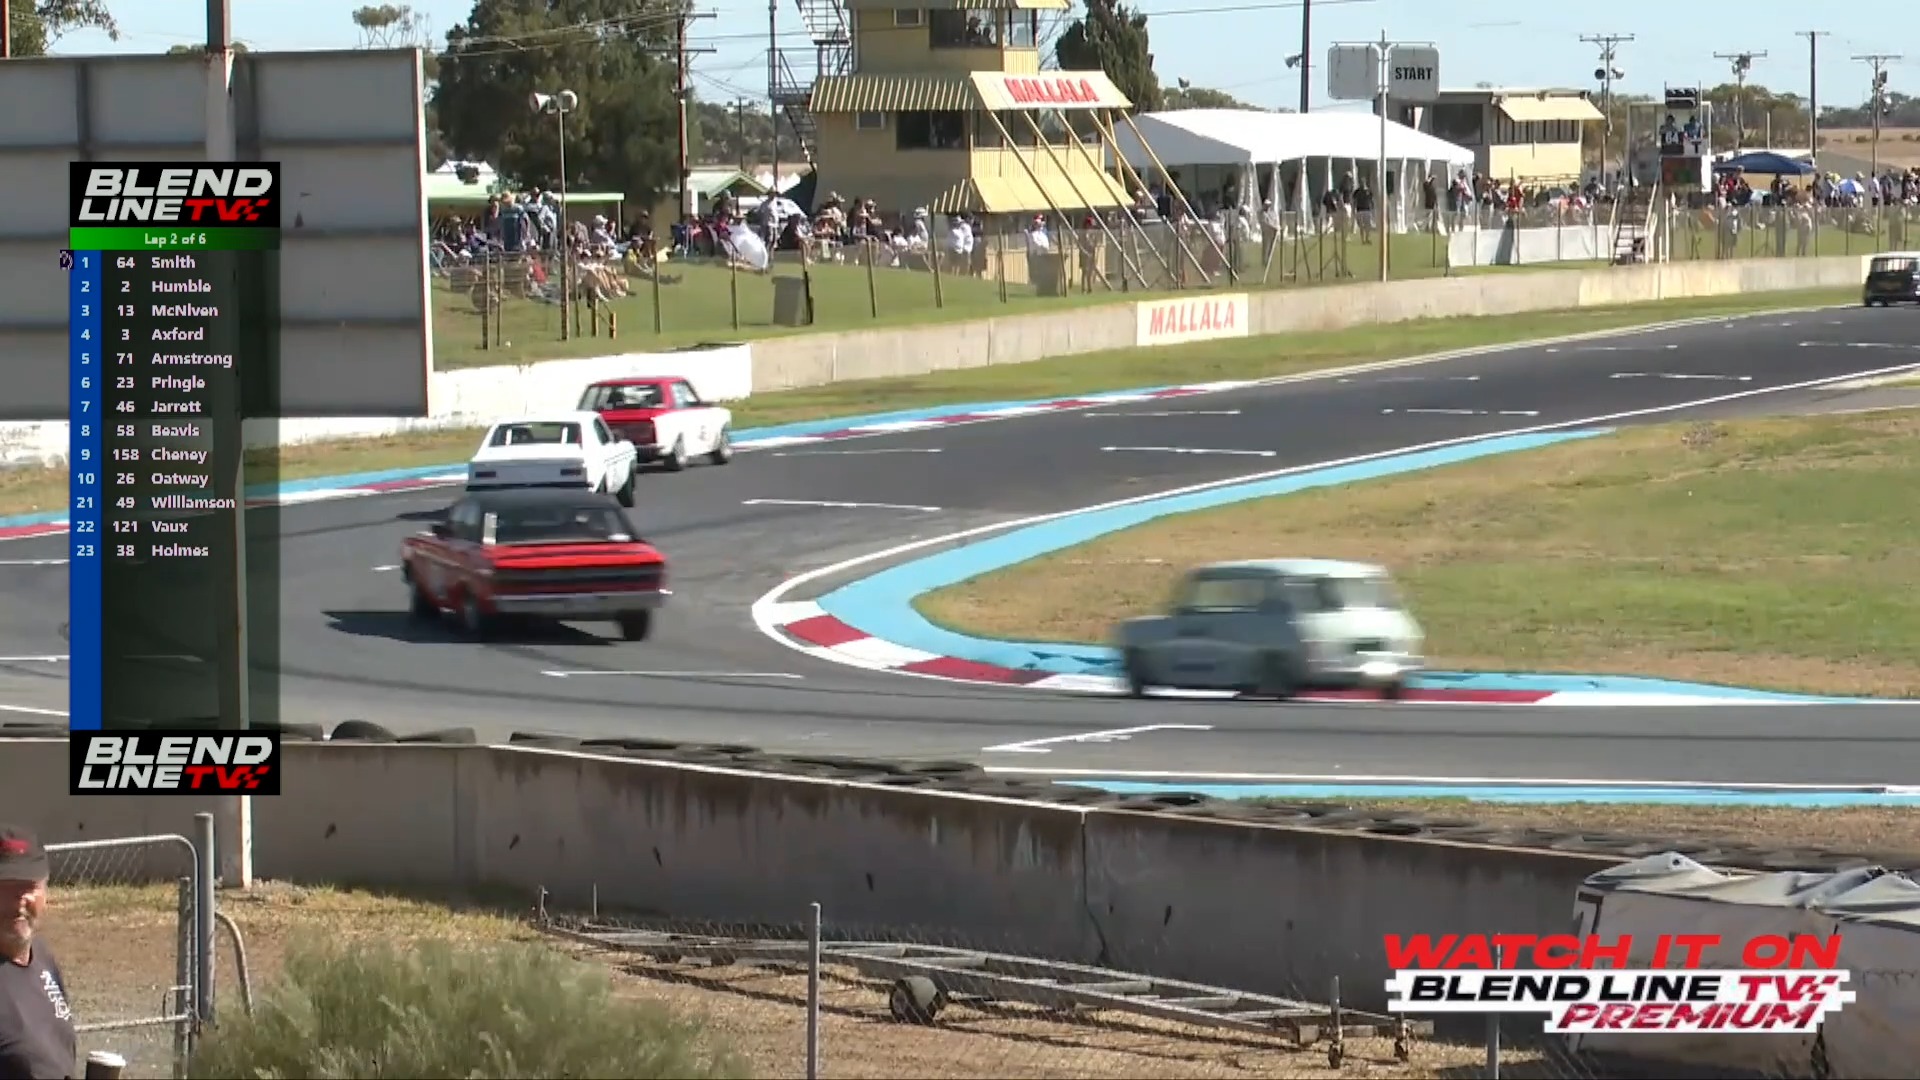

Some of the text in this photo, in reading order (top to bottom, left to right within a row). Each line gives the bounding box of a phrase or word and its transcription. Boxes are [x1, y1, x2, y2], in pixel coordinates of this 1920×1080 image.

[1395, 66, 1433, 80] START
[1004, 77, 1100, 103] MALLALA
[1149, 301, 1235, 335] MALLALA
